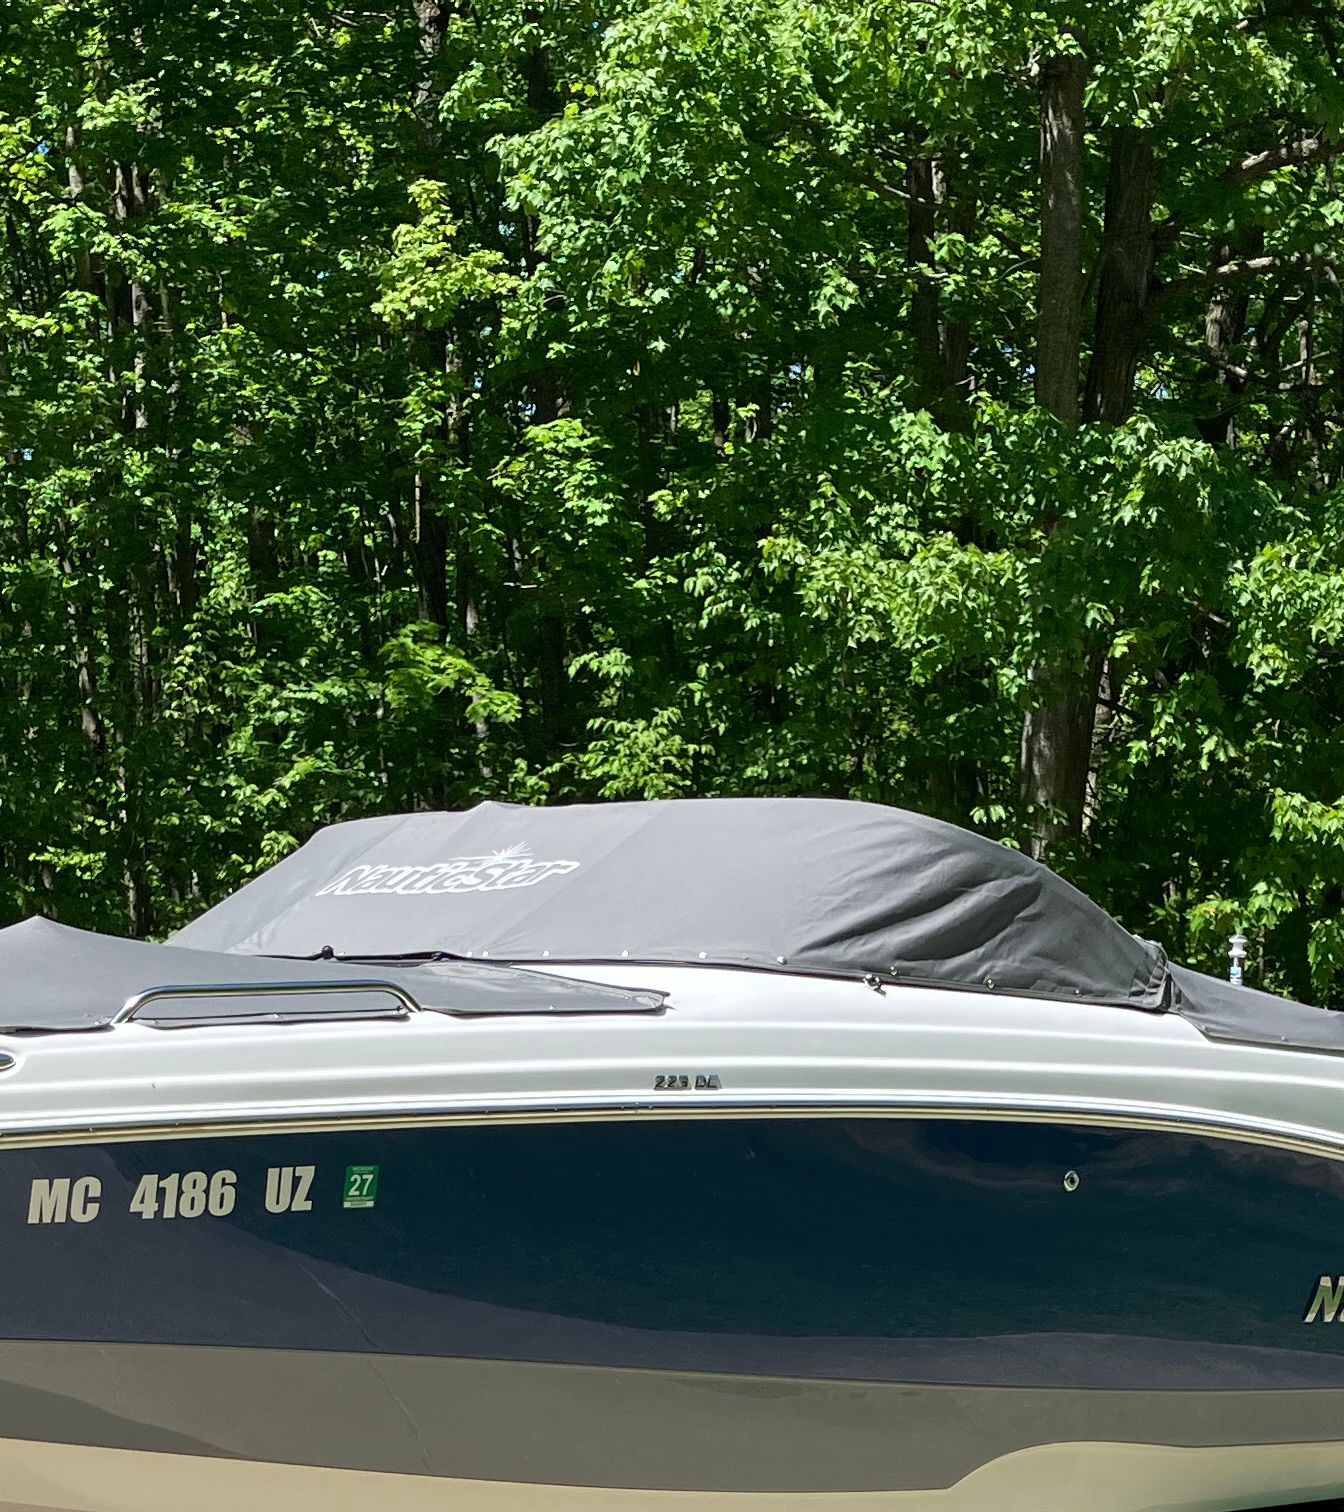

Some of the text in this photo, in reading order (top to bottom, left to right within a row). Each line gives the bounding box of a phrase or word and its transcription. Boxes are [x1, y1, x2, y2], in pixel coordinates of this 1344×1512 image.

[28, 1165, 316, 1224] MC 4186 UZ
[348, 1174, 374, 1196] 27
